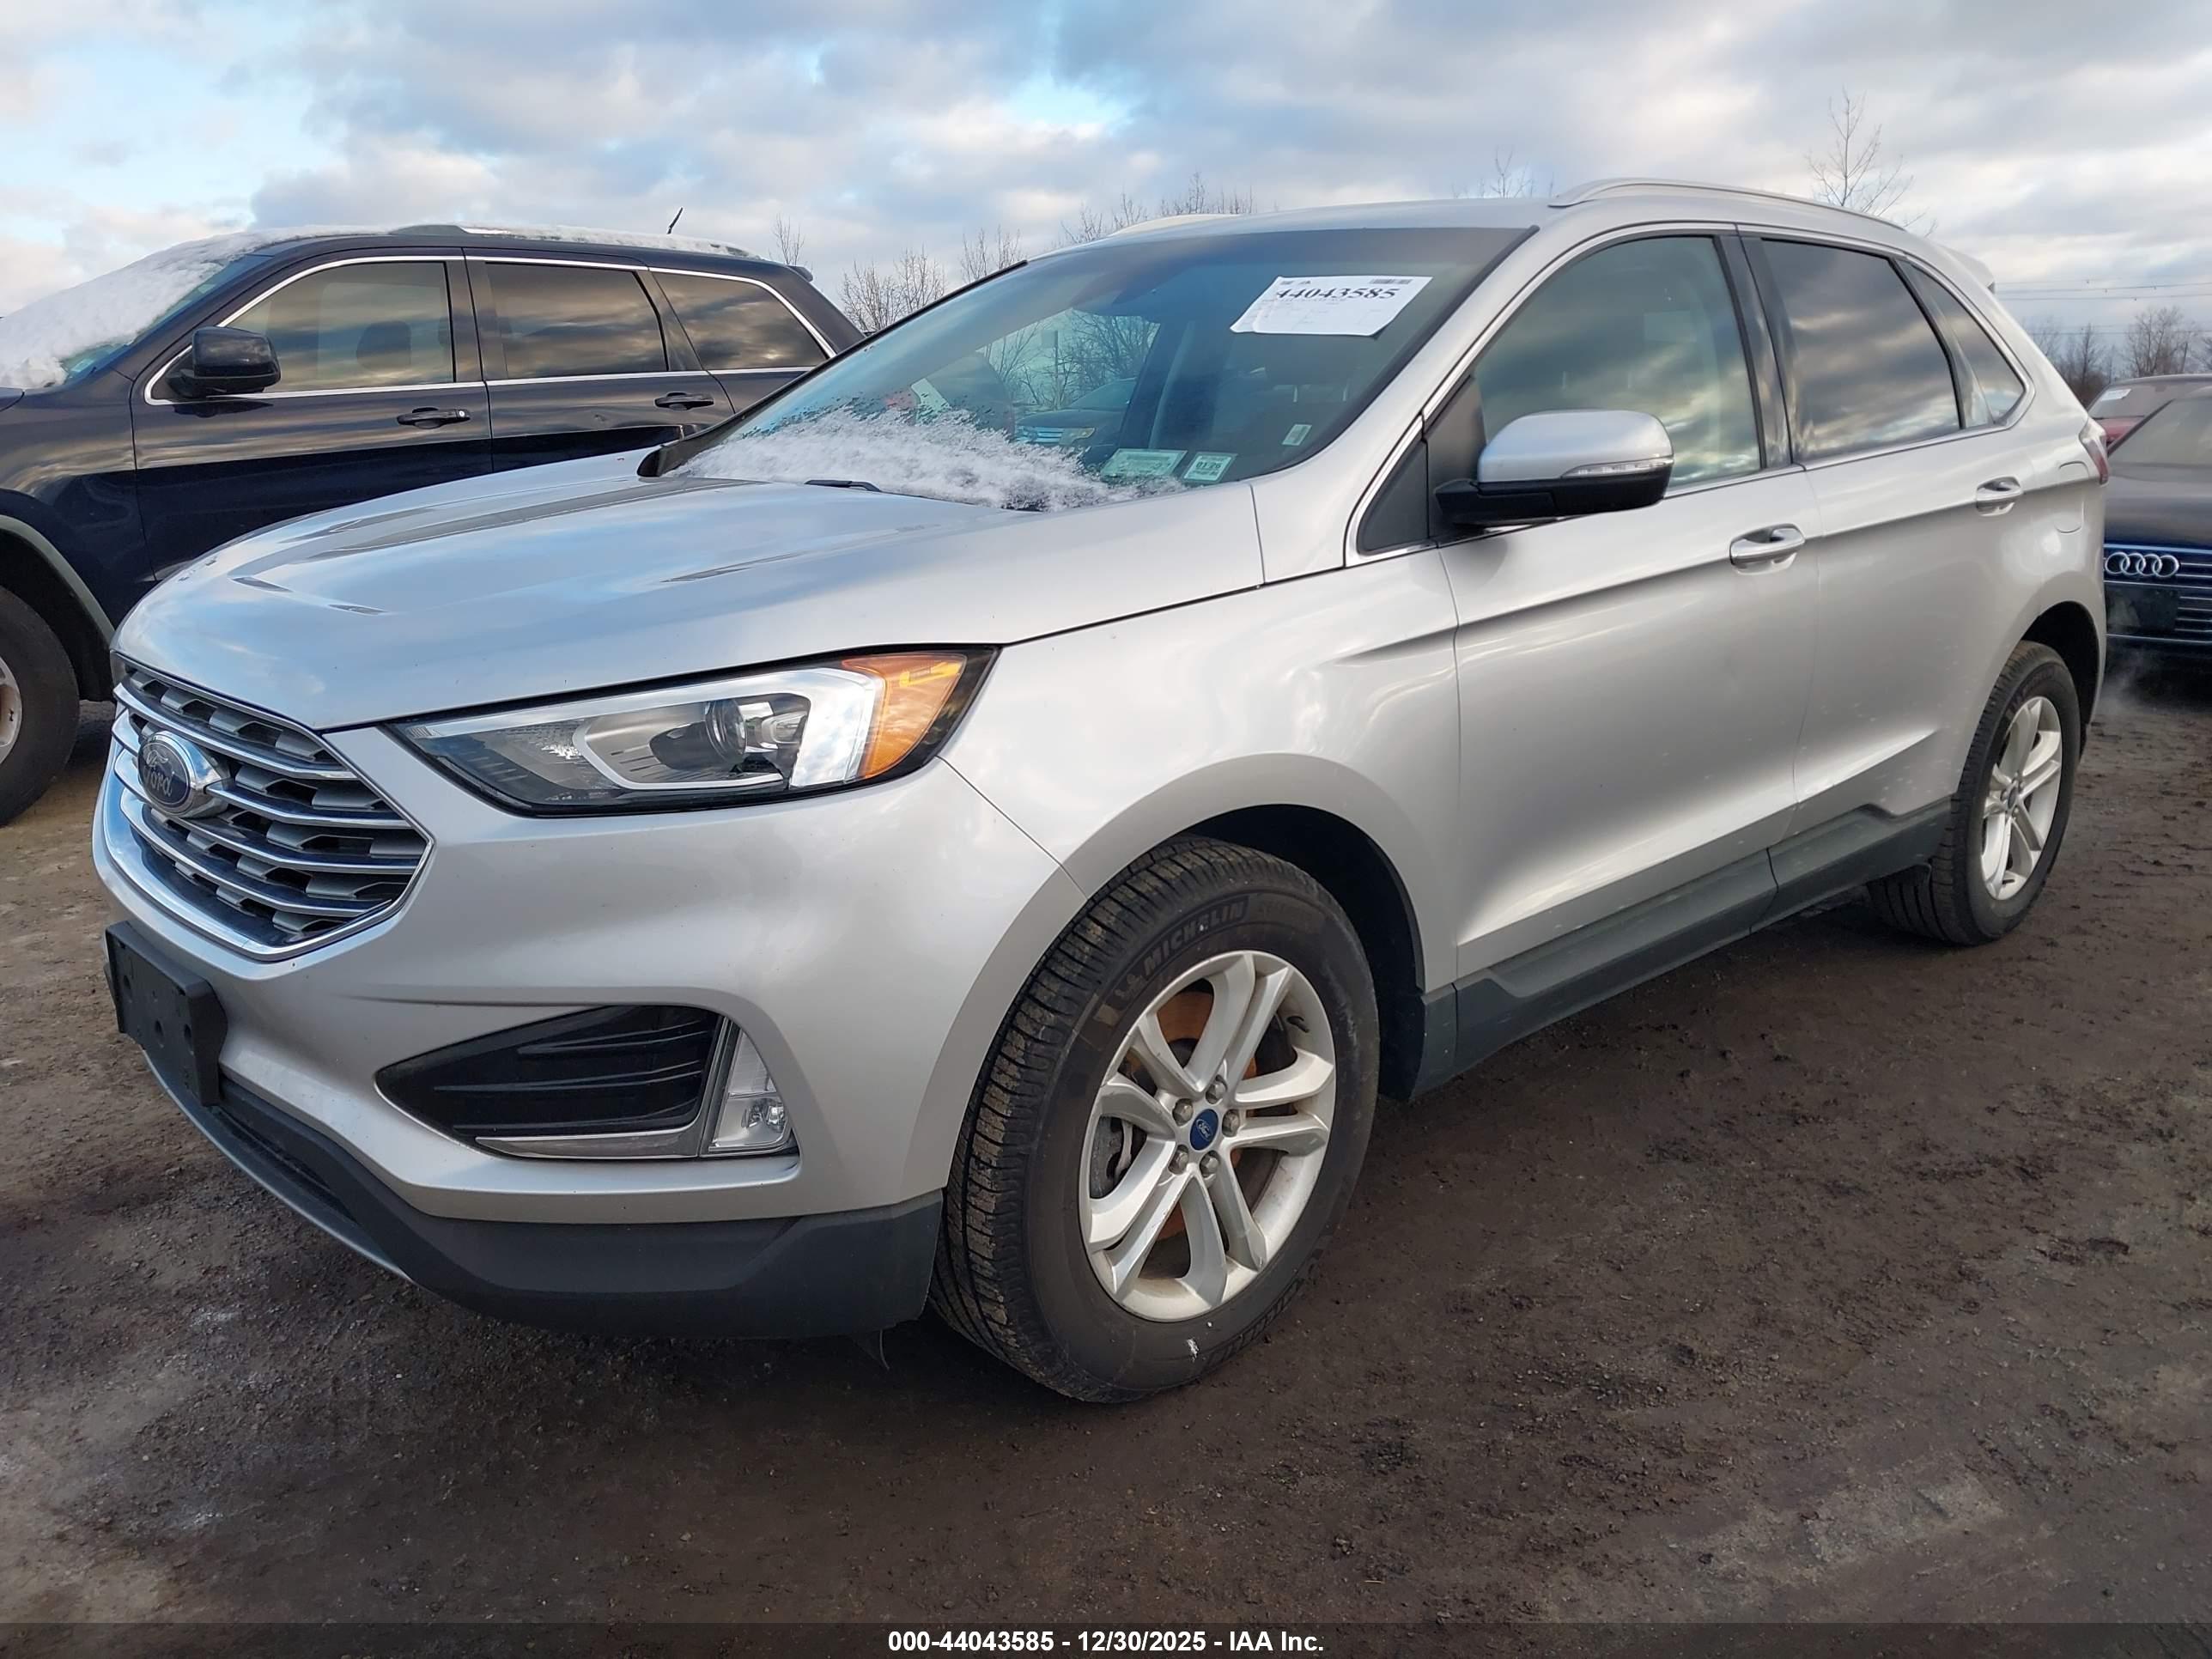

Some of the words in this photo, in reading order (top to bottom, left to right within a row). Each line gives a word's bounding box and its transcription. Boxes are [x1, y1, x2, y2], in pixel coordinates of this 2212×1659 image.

[1276, 288, 1400, 300] 44043585
[144, 749, 173, 797] Ford
[1143, 901, 1244, 977] MICHELIN
